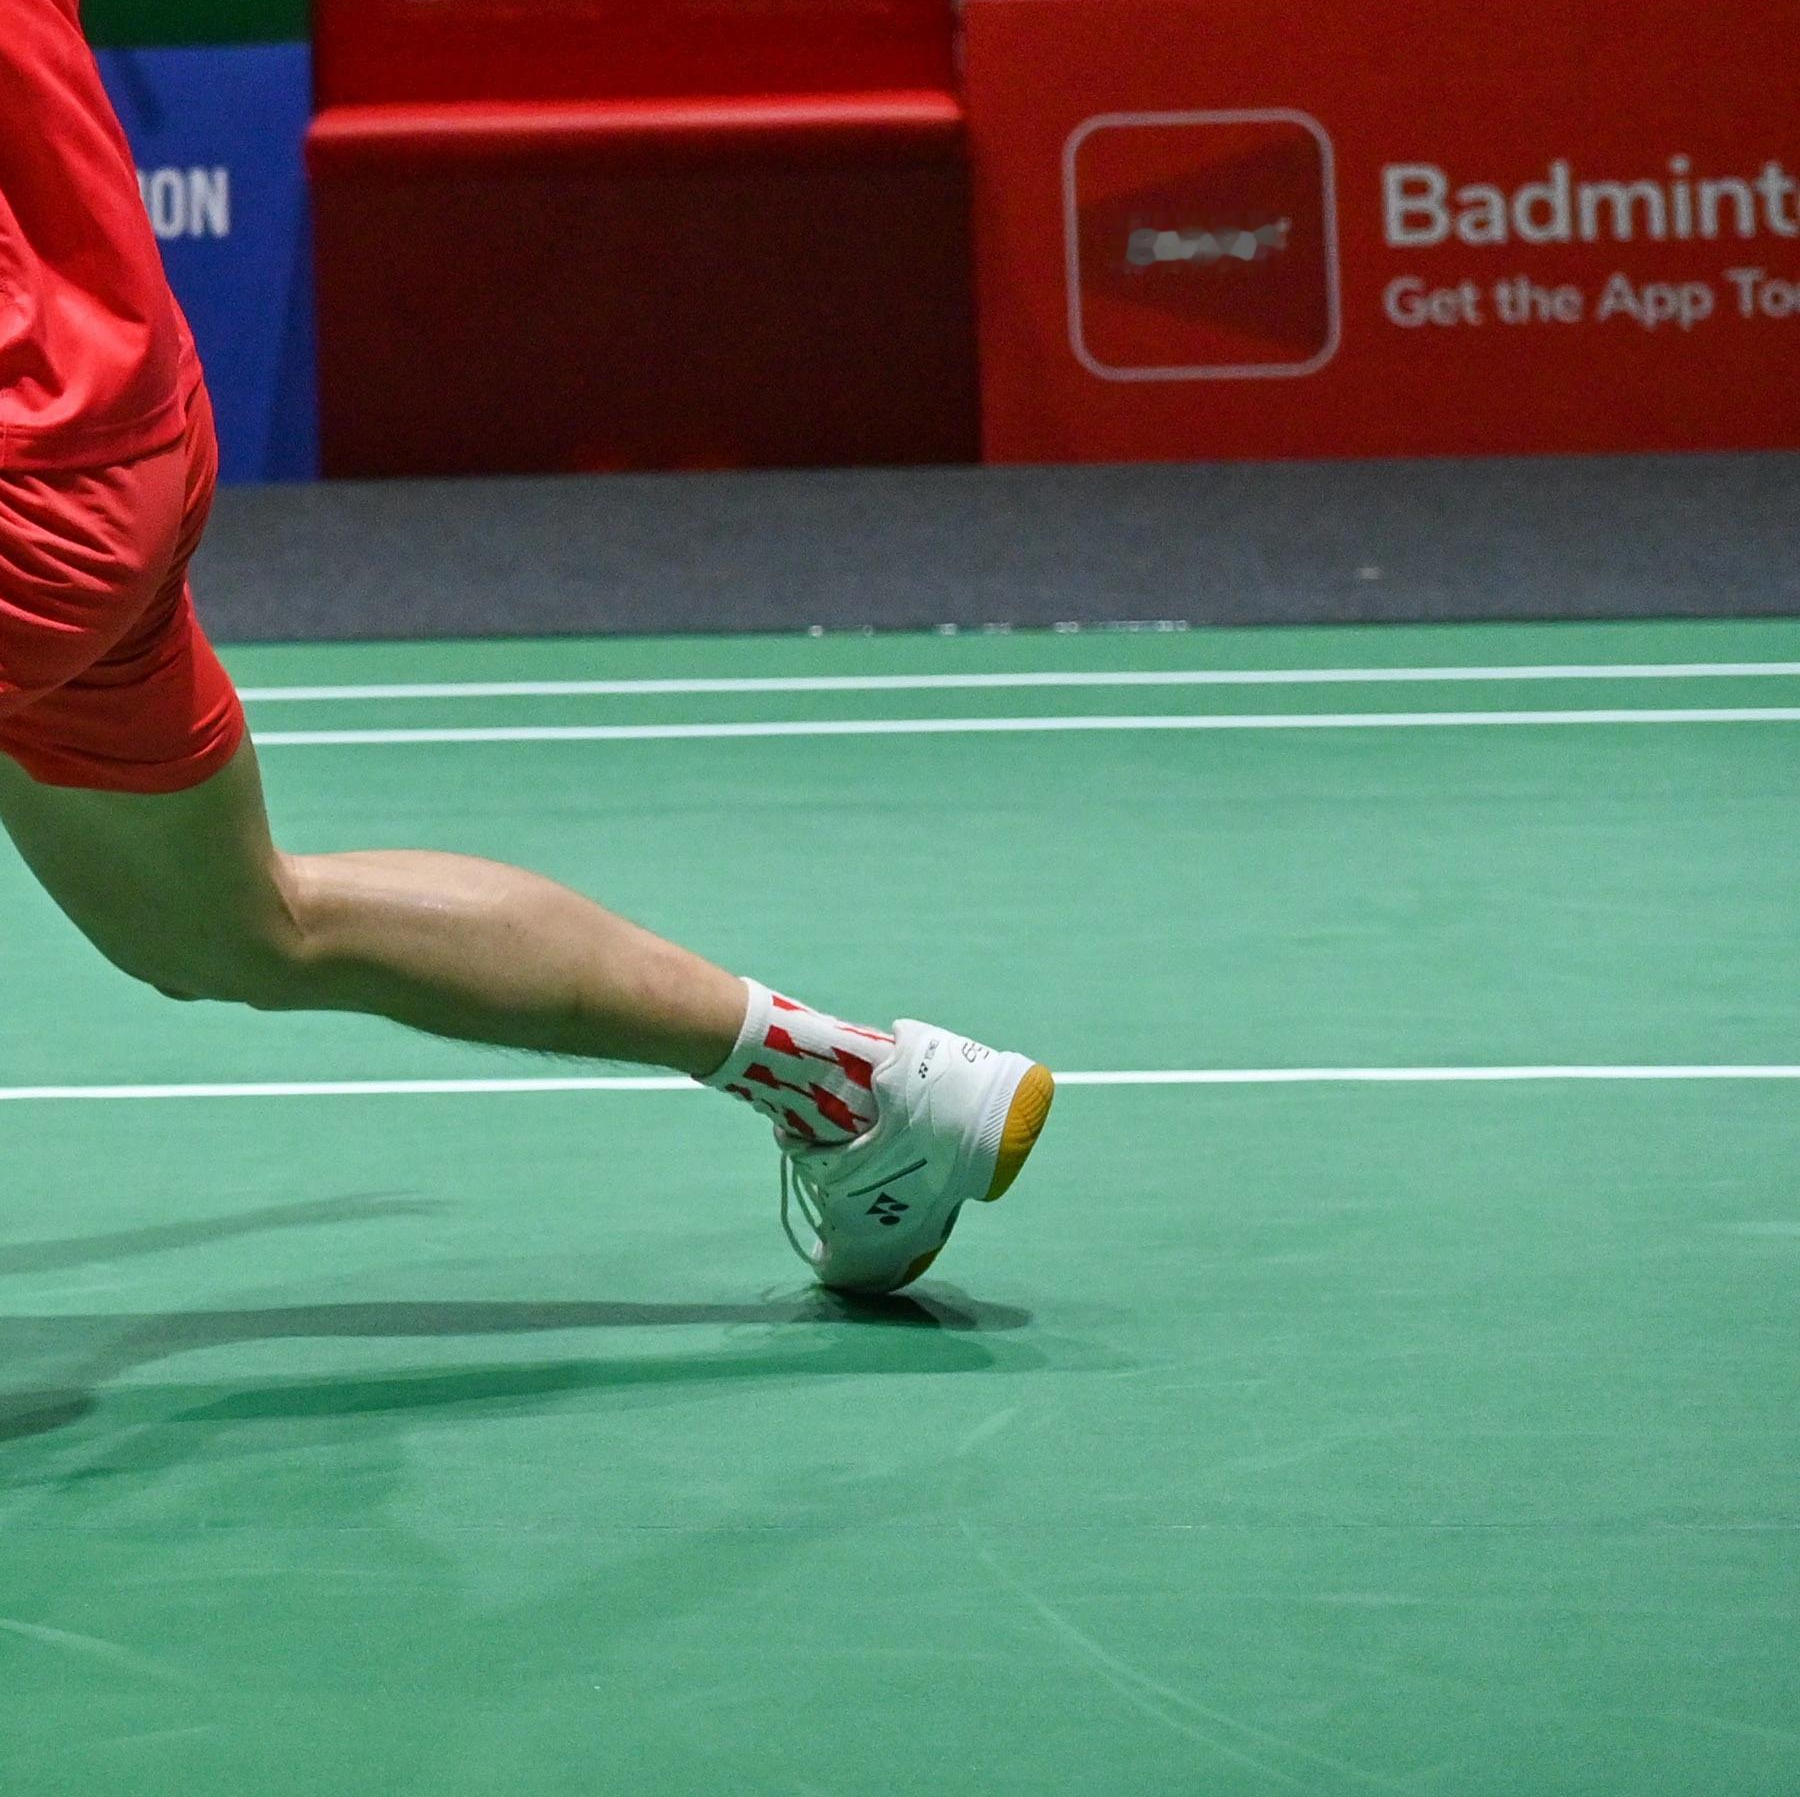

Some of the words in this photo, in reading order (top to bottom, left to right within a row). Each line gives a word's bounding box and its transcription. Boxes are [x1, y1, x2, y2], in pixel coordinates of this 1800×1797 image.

[1382, 154, 1800, 247] Badmint
[1384, 276, 1481, 327] Get
[1493, 276, 1584, 324] the
[1596, 272, 1714, 331] App
[1723, 267, 1800, 318] To
